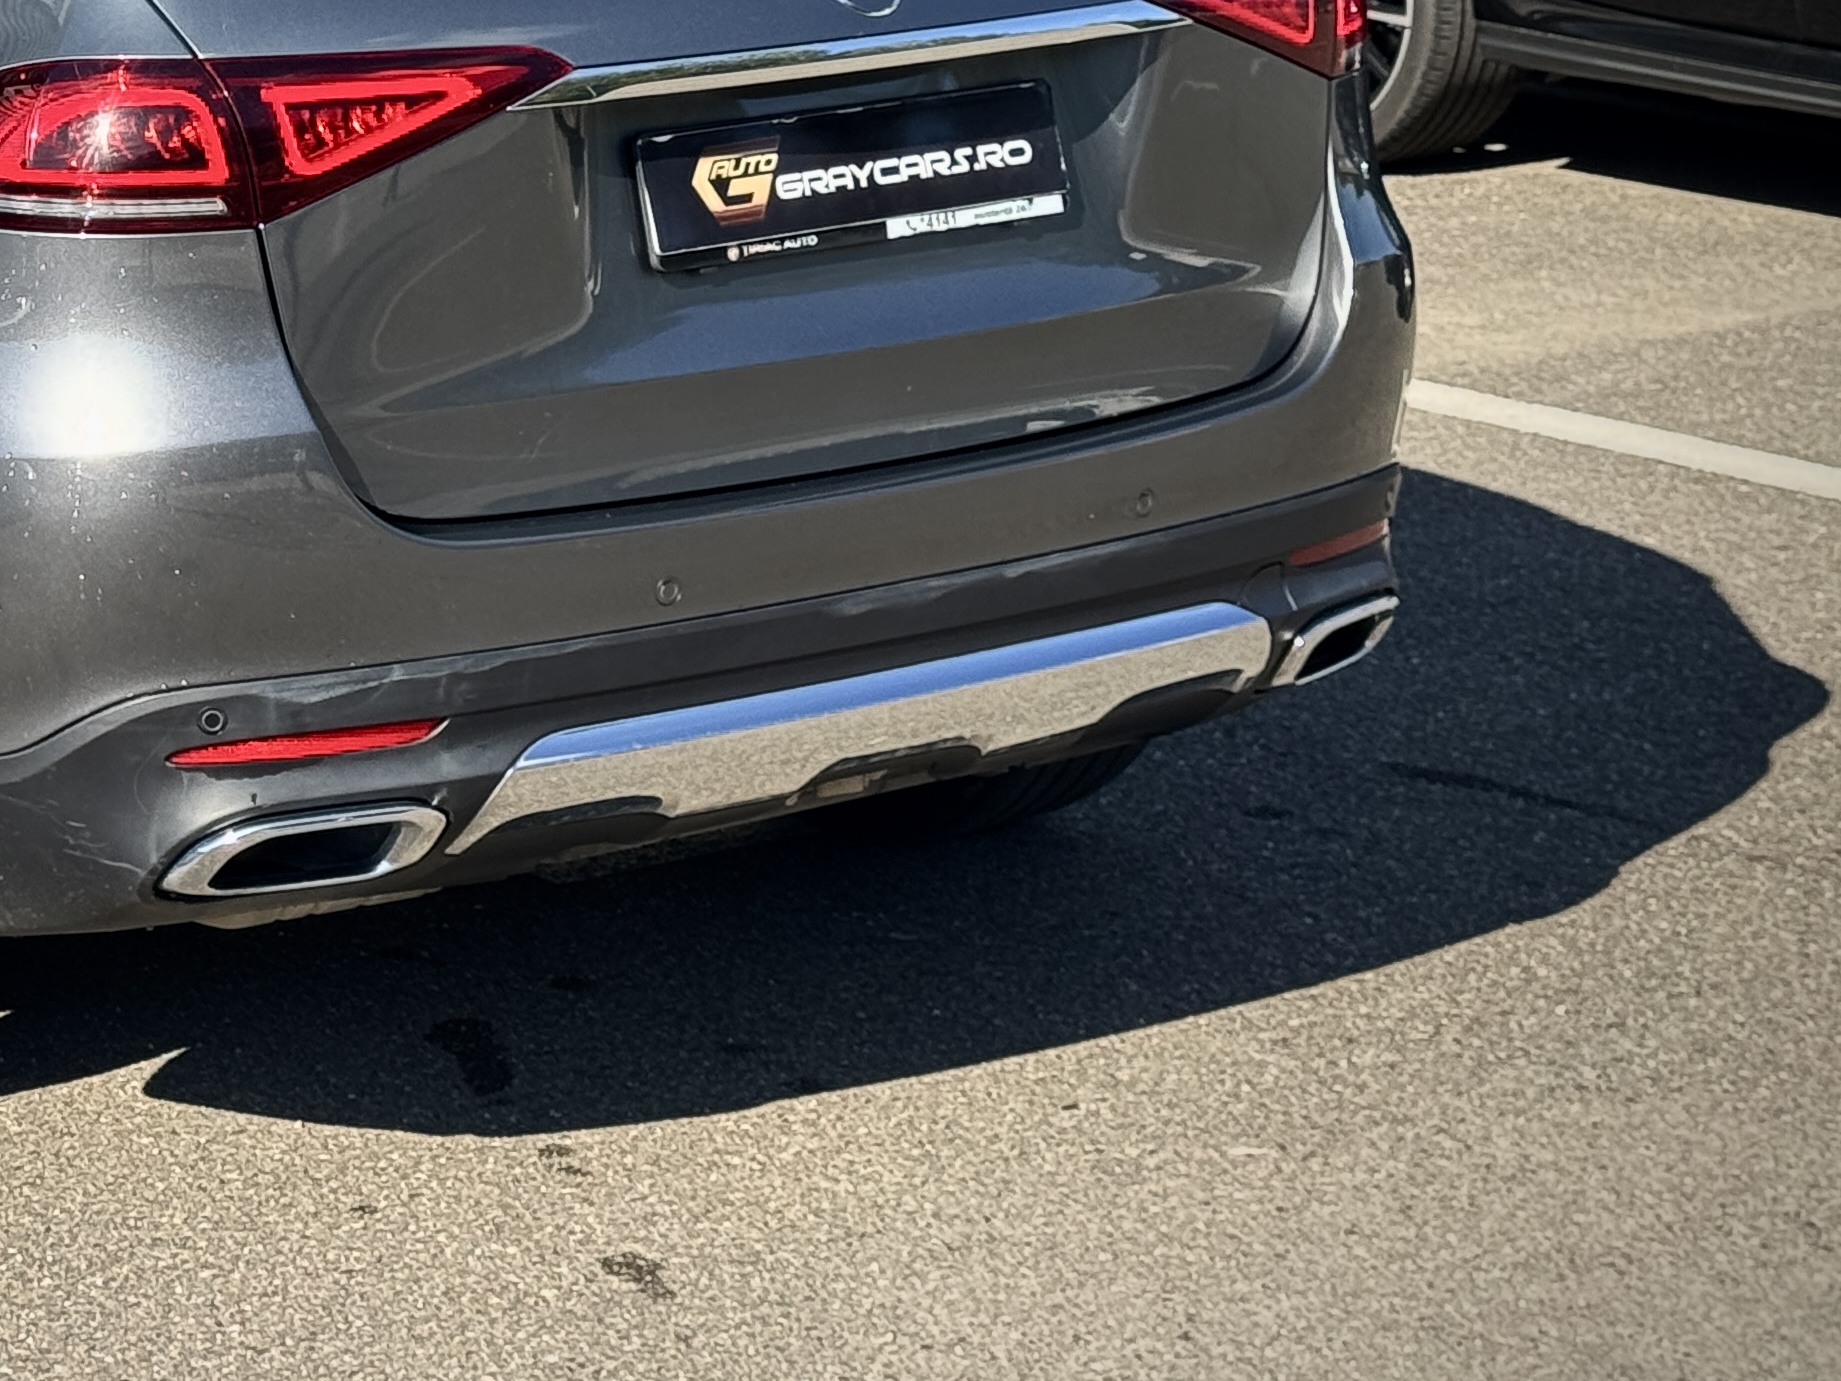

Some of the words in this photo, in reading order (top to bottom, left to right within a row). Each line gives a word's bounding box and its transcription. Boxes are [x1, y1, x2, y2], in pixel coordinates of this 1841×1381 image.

[710, 153, 779, 180] AUTO
[775, 139, 1033, 200] GRAYCARS.RO
[783, 234, 819, 250] AUTO
